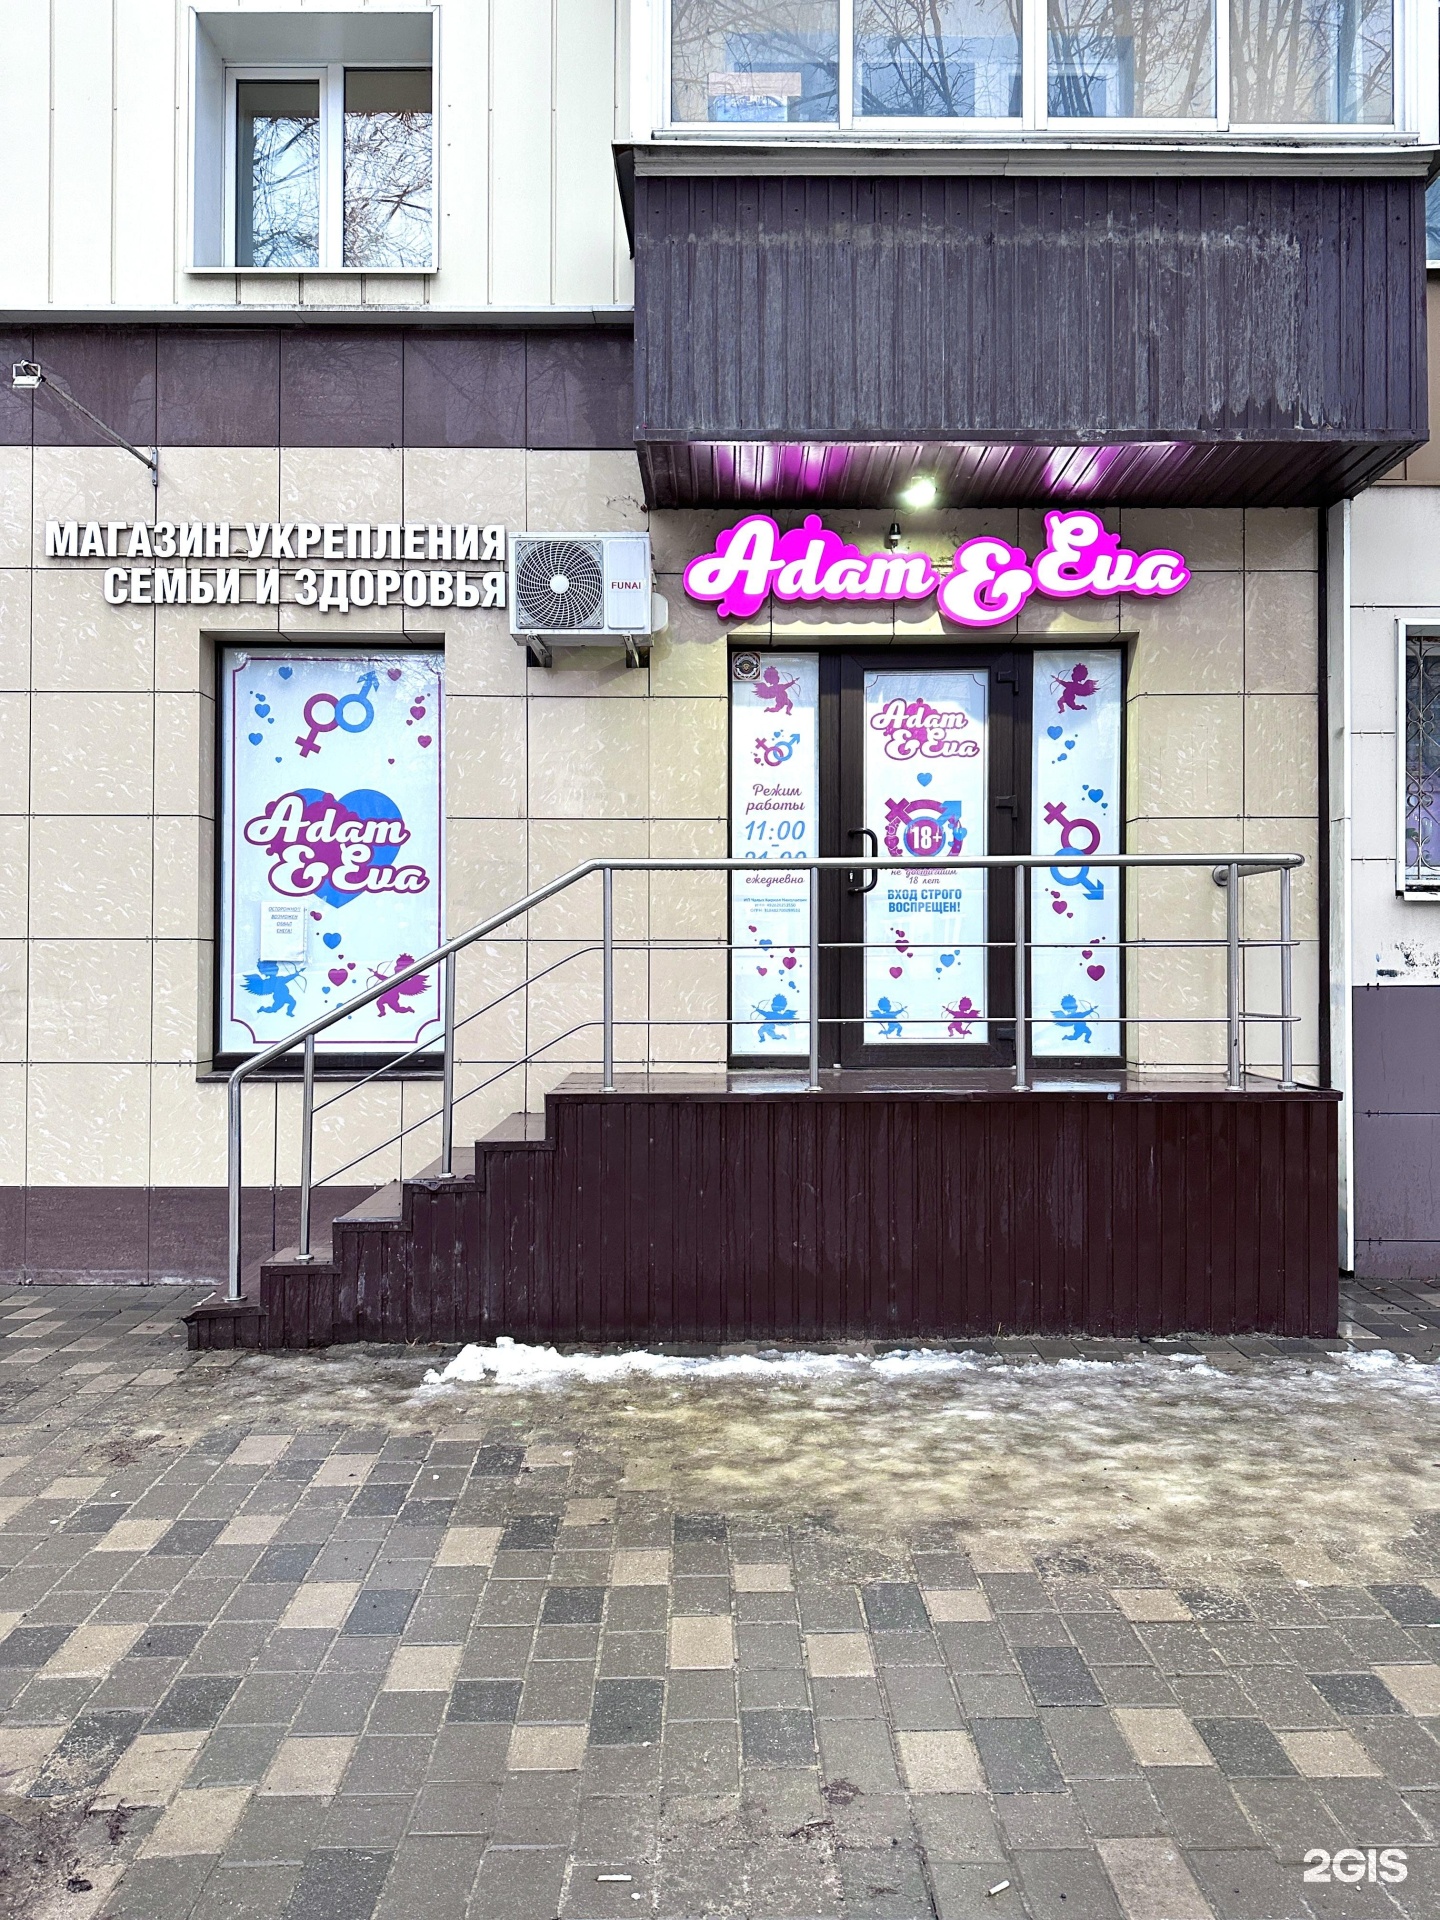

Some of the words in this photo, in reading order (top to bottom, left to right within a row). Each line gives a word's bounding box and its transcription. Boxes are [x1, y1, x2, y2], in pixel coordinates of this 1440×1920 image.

[45, 520, 230, 558] МАГАЗИН
[245, 522, 506, 561] УКРЕПЛЕНИЯ
[686, 518, 936, 597] Adam
[942, 541, 1033, 621] &
[1036, 514, 1186, 592] Eva
[103, 567, 240, 605] СЕМЬИ
[256, 568, 280, 605] И
[294, 568, 506, 613] ЗДОРОВЬЯ
[611, 581, 642, 590] FUNAI
[870, 699, 968, 729] Adam
[885, 728, 920, 760] &
[920, 727, 980, 758] Eva
[752, 783, 802, 796] Режим
[745, 798, 805, 815] работы
[246, 794, 409, 844] Adam
[745, 820, 806, 841] 11:00
[910, 825, 943, 850] 18+
[270, 843, 330, 893] &
[331, 842, 428, 891] Eva
[745, 873, 805, 887] ежедневно
[909, 876, 919, 885] 18
[887, 889, 918, 901] ВХОД
[921, 889, 962, 900] СТРОГО
[888, 902, 961, 914] ВОСПРЕЩЕН!
